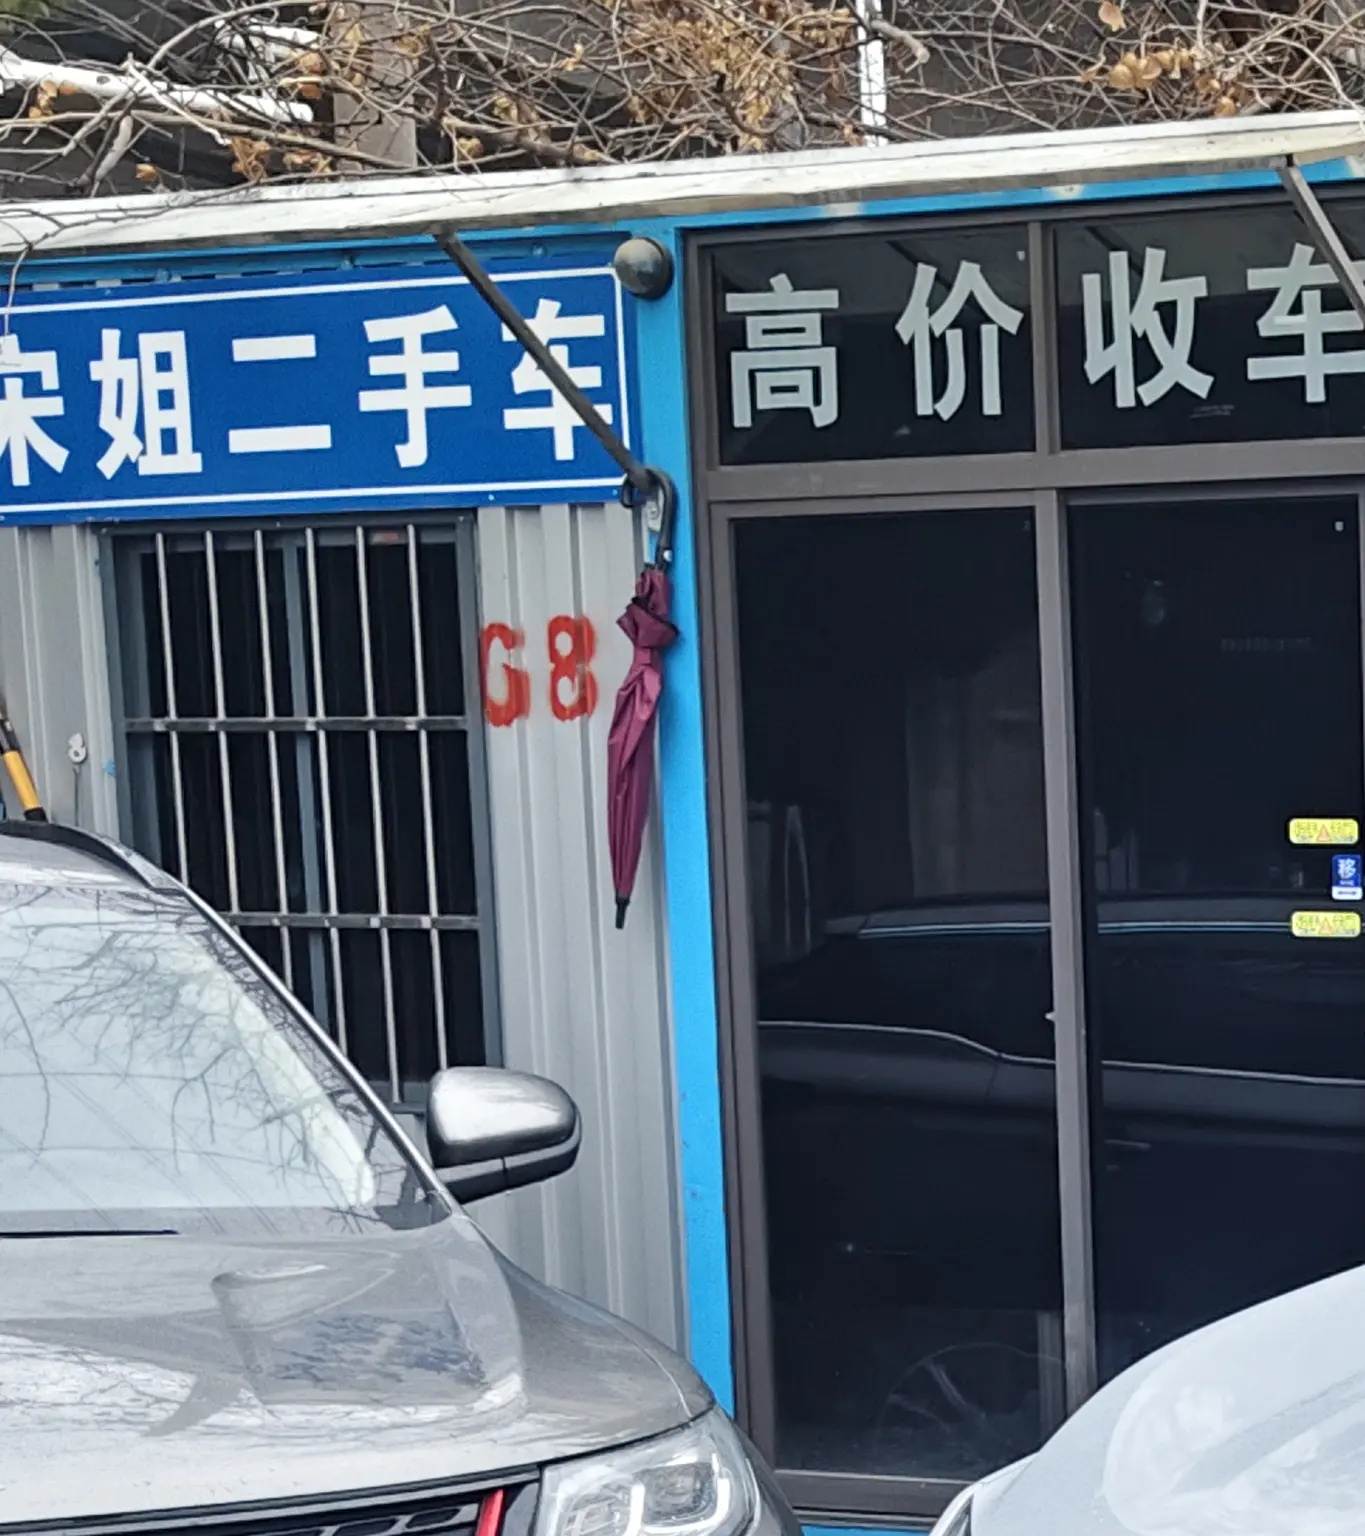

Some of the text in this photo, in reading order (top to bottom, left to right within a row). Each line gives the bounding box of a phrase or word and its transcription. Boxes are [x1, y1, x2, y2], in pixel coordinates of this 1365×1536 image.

[0, 298, 614, 487] 宋姐二手车
[479, 614, 599, 728] G8
